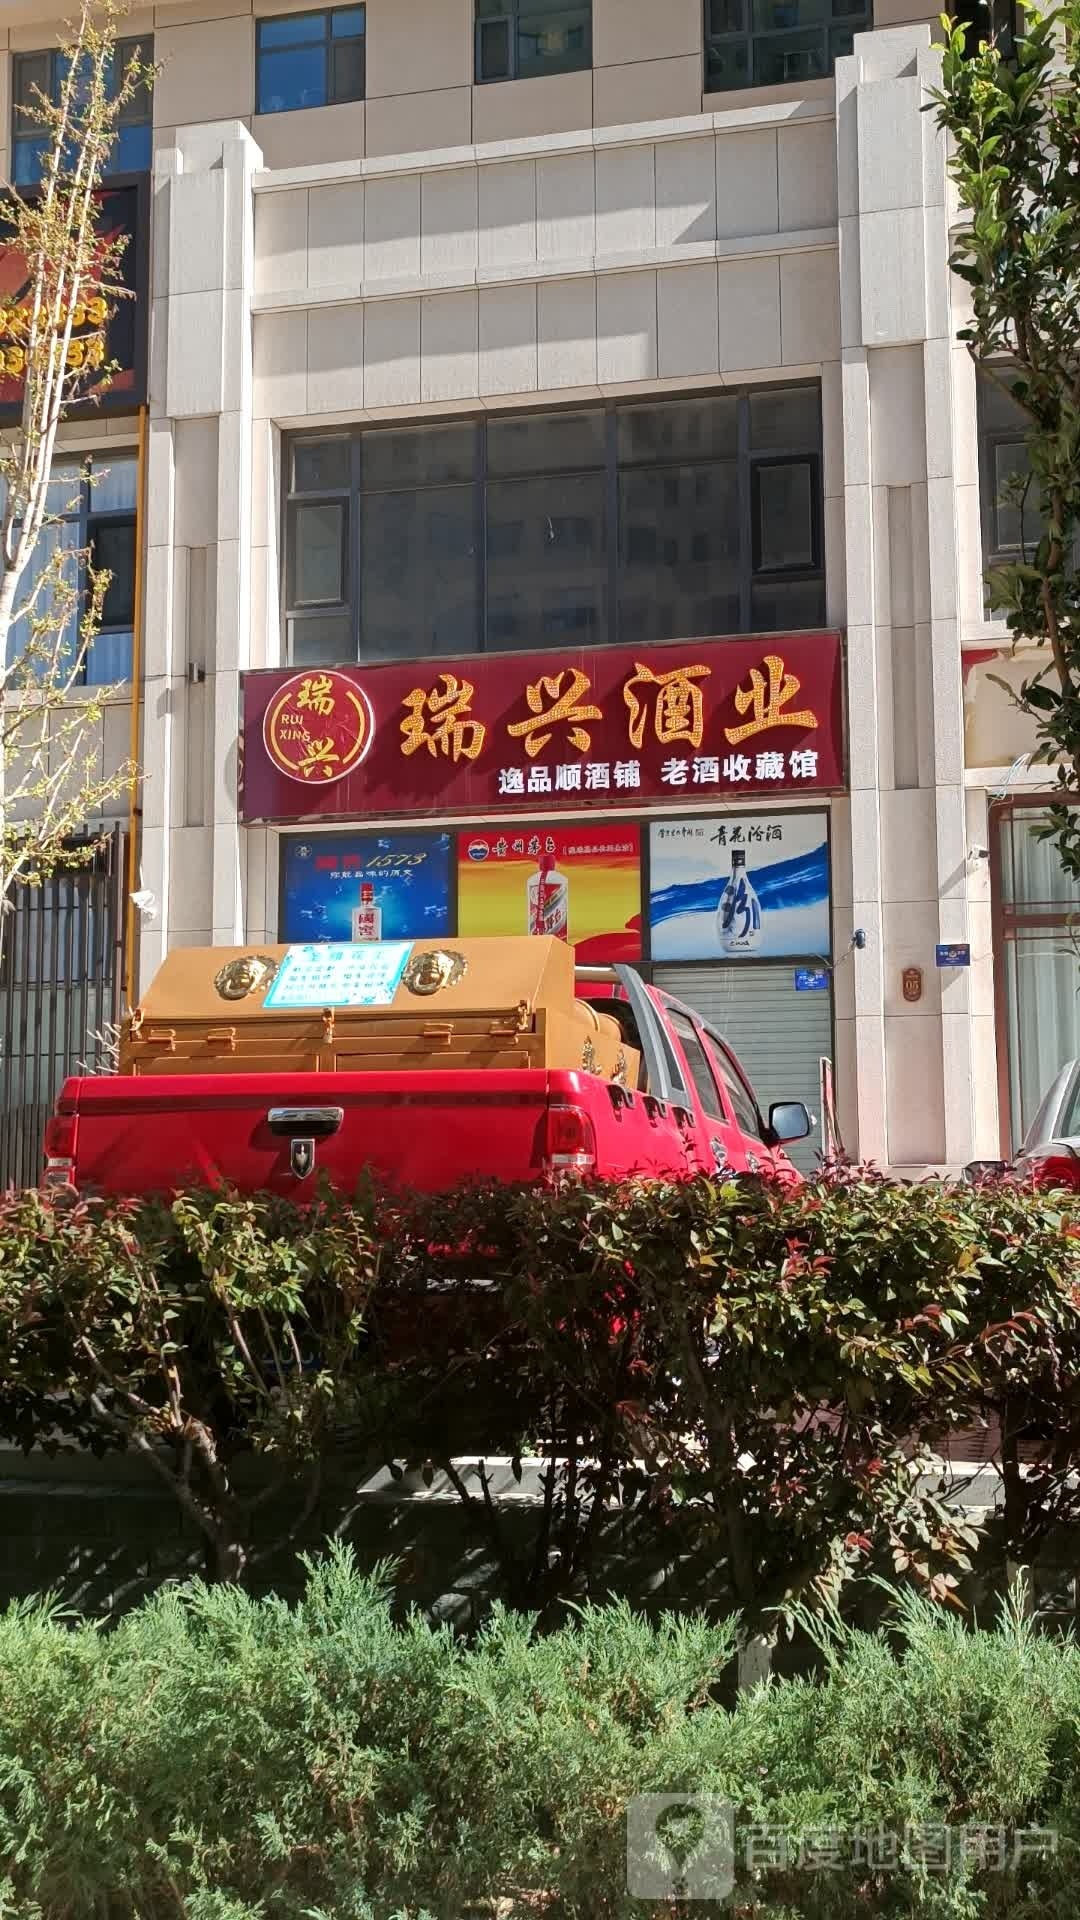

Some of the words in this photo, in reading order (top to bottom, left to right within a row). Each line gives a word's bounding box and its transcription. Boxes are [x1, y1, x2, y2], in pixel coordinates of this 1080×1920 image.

[297, 675, 335, 716] 瑞
[401, 655, 818, 762] 瑞兴酒业
[281, 714, 304, 724] RUI
[280, 730, 311, 741] XING
[298, 737, 340, 777] 兴
[498, 760, 641, 795] 逸品顺酒铺
[660, 749, 819, 785] 老酒收藏馆
[710, 825, 782, 846] 青花汾酒
[365, 852, 428, 868] 1573
